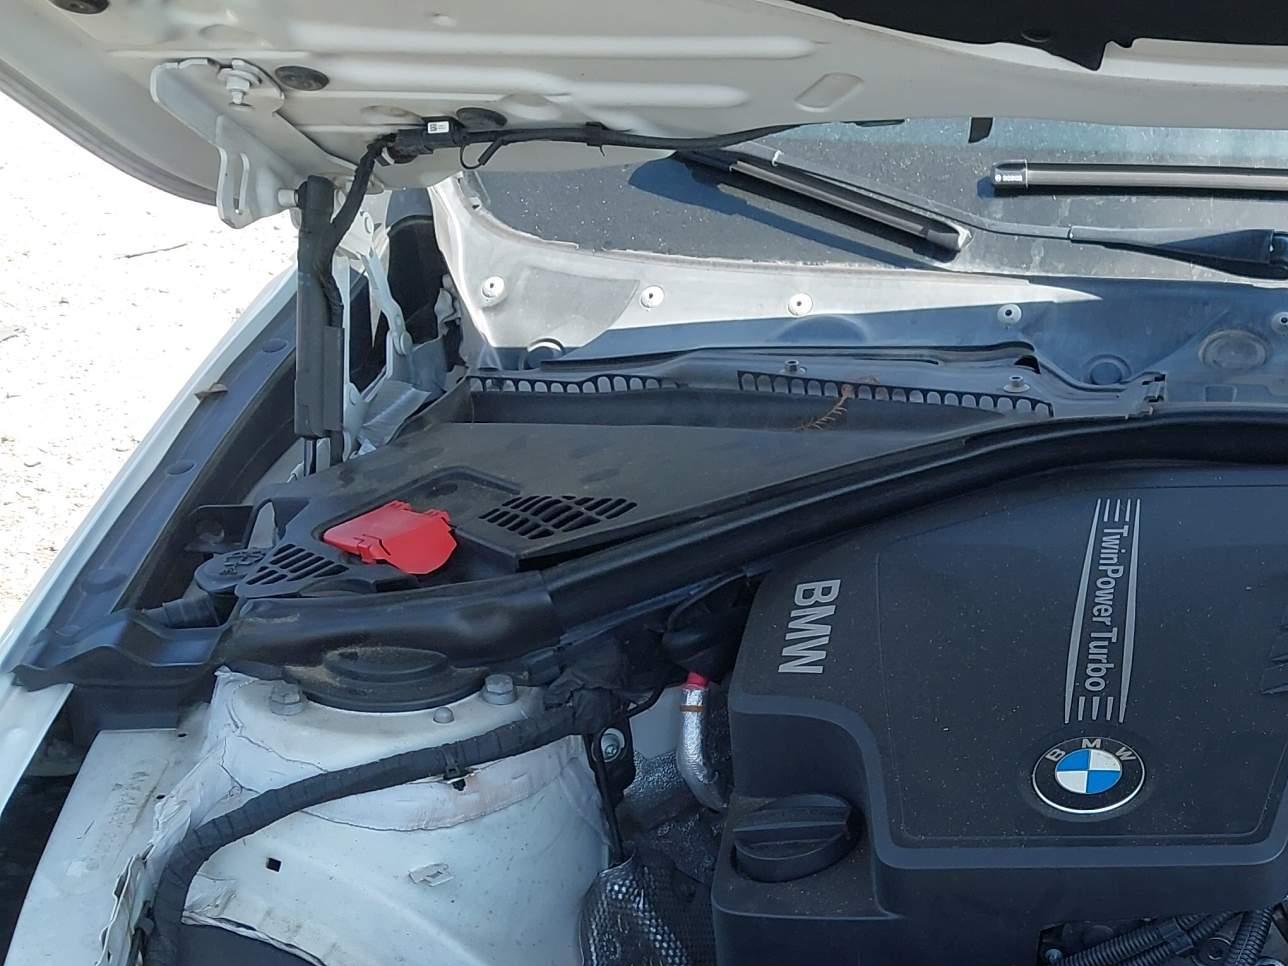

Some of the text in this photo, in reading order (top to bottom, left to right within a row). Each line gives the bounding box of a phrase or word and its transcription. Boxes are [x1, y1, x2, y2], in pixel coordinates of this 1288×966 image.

[777, 579, 841, 674] BMW
[1084, 524, 1129, 692] TwinPower Turbo
[1045, 738, 1137, 762] BMW
